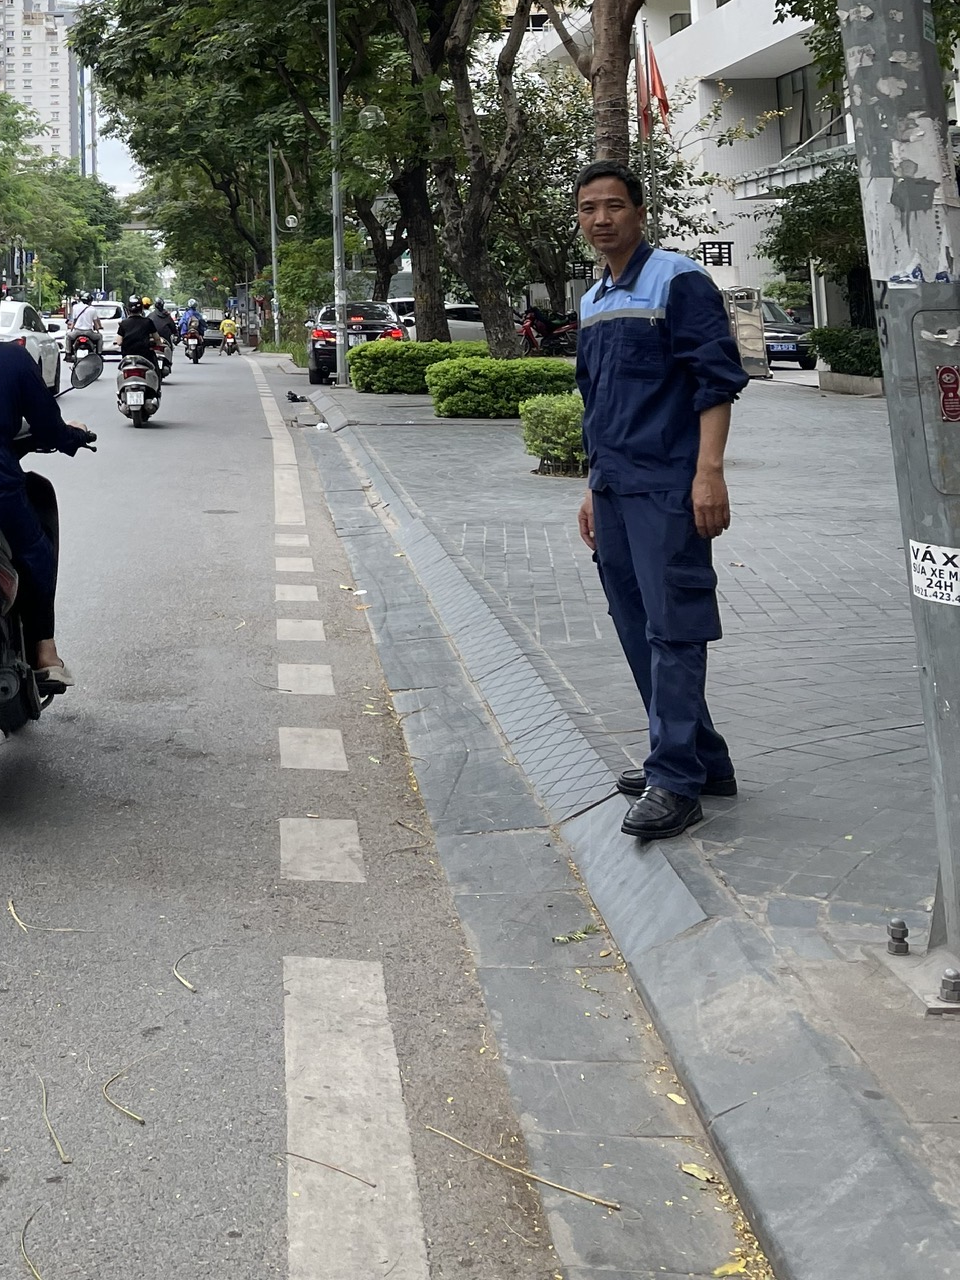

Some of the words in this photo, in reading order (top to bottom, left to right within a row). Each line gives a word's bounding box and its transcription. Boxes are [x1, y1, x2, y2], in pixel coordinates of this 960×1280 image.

[912, 546, 937, 565] VÁ
[930, 567, 945, 579] XE
[926, 578, 953, 593] 24H
